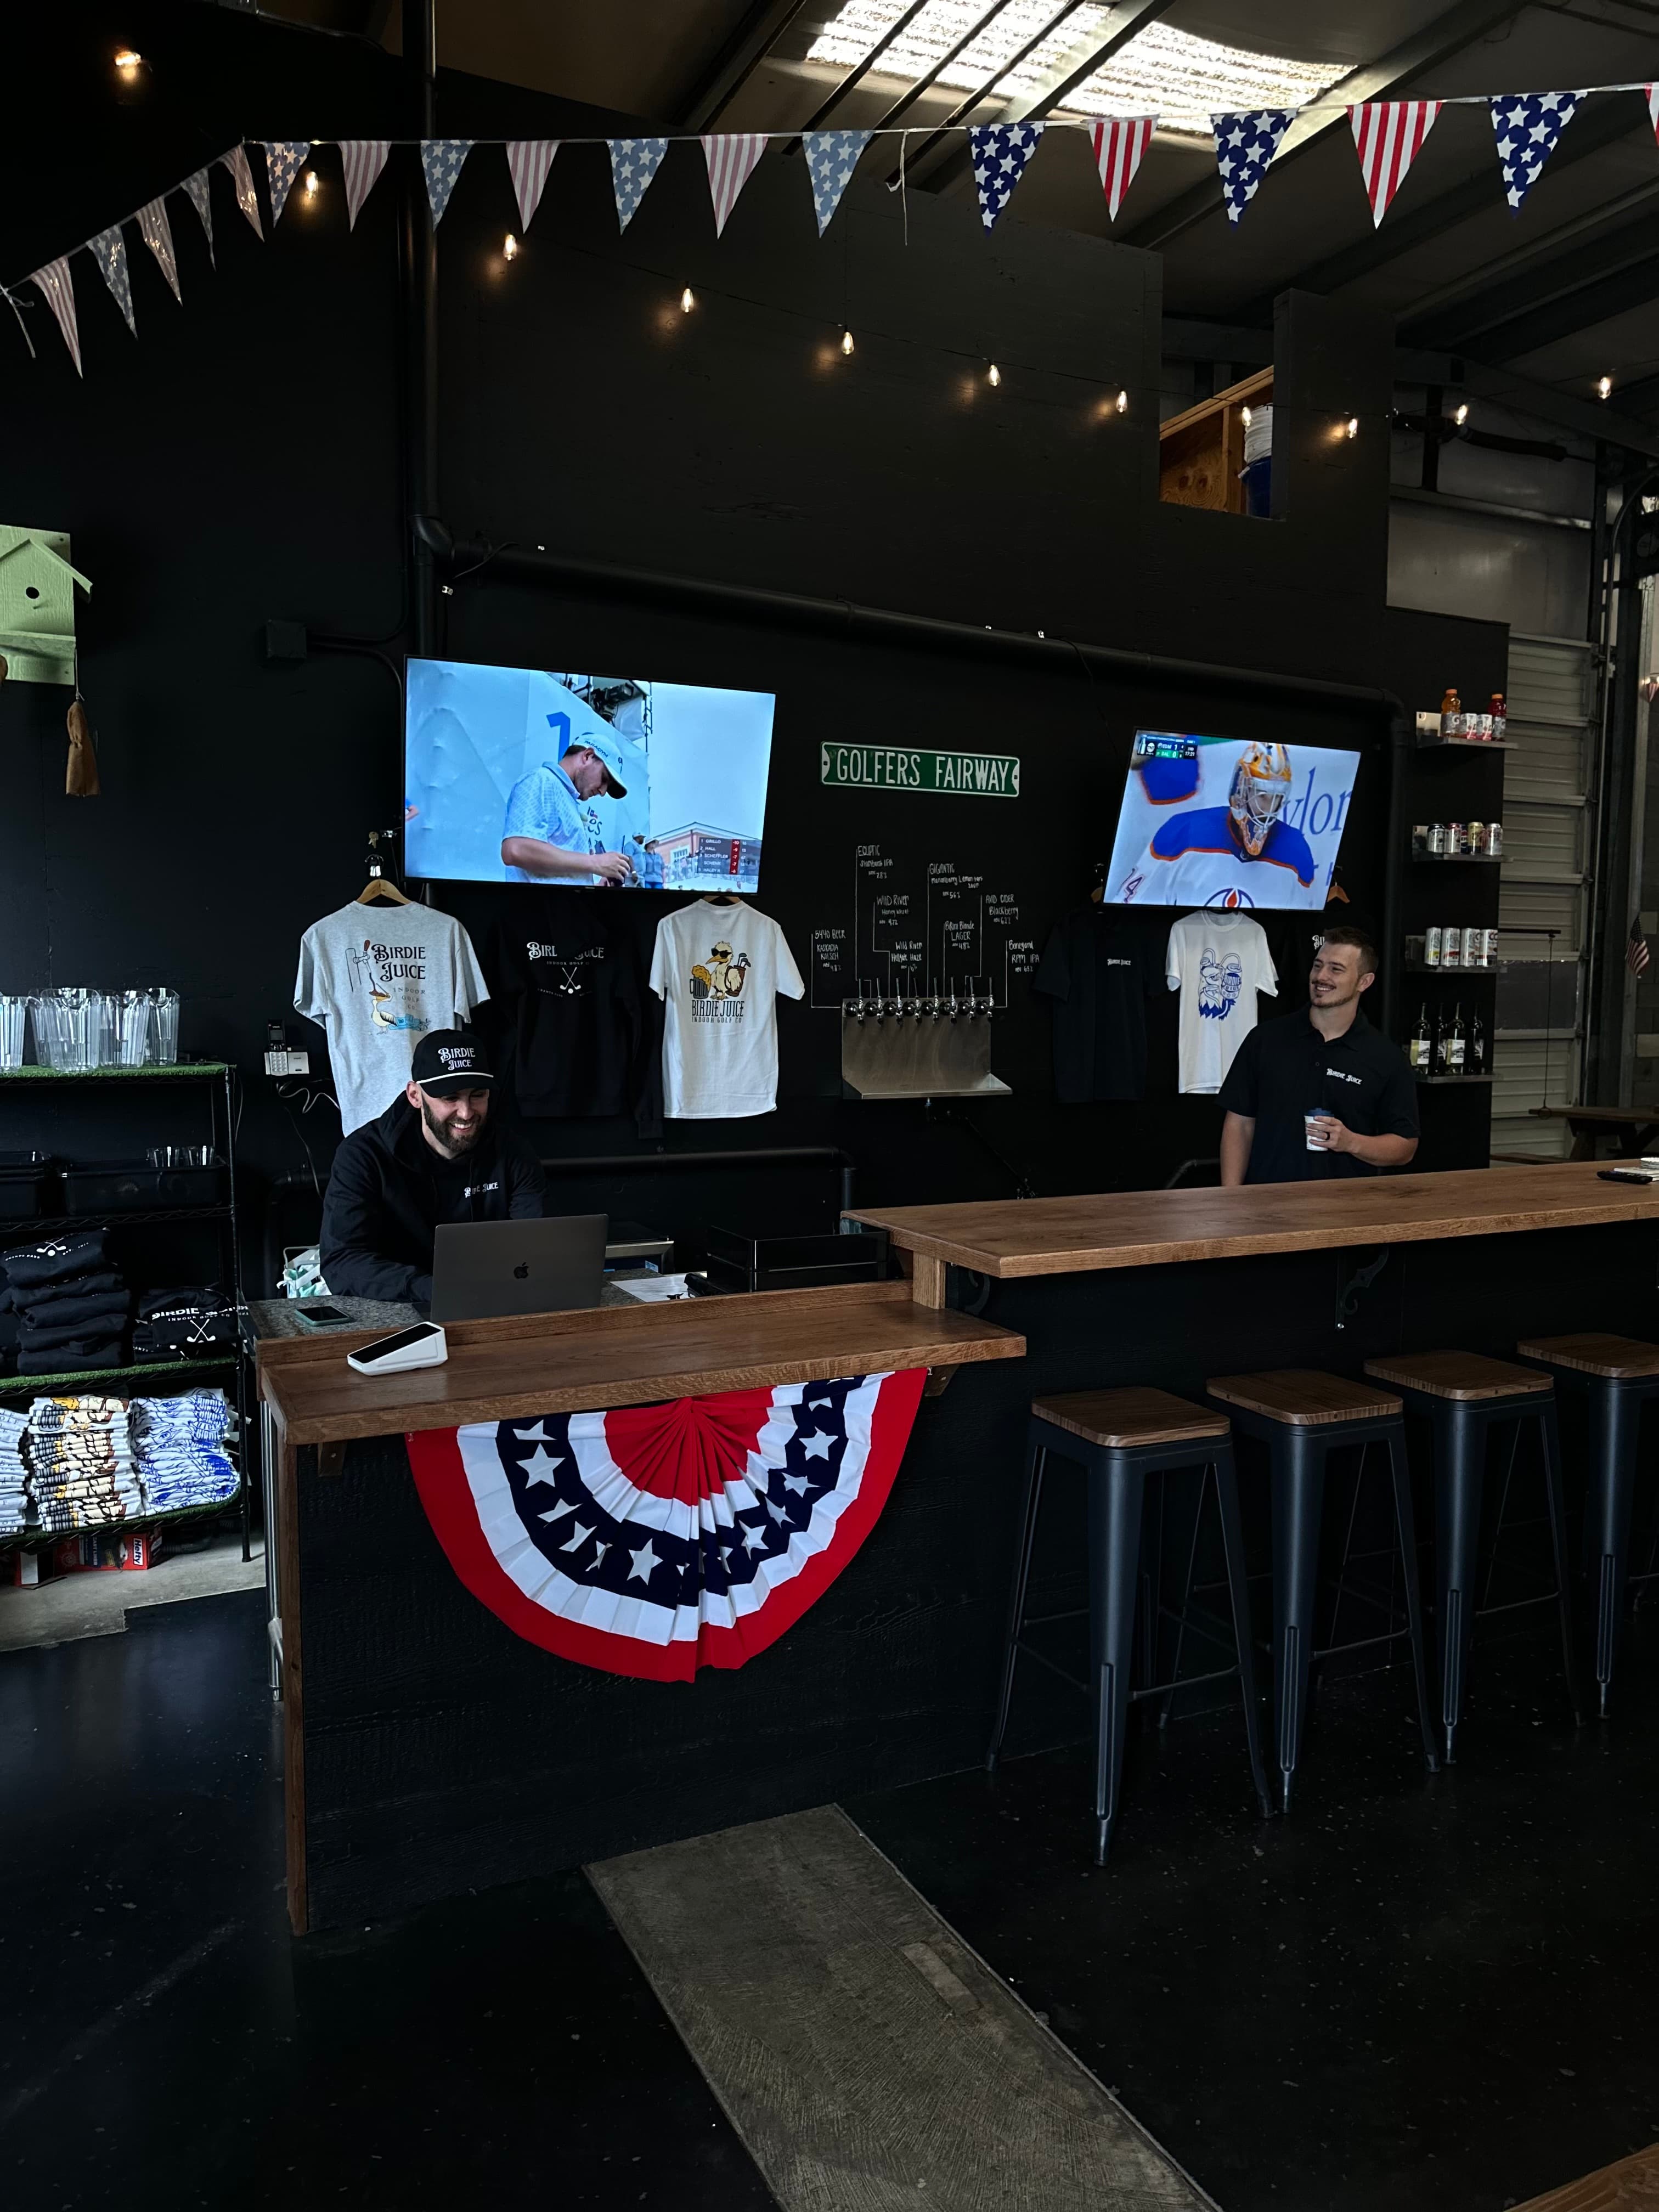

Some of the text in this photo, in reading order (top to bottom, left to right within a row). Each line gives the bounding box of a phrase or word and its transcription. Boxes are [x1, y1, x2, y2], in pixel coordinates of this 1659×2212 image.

[584, 740, 608, 758] PARADYM
[837, 748, 1009, 791] GOLFERS FAIRWAY
[815, 929, 831, 939] 5440
[951, 931, 971, 941] LAGER
[371, 944, 426, 964] BIRDIE
[1012, 953, 1040, 964] RPM IPA
[380, 962, 426, 982] JUICE
[393, 987, 426, 995] INDOOR
[692, 1000, 745, 1017] BIRDIE JUICE
[438, 1047, 476, 1063] BIRDIE
[448, 1059, 472, 1071] JUICE
[1327, 1068, 1362, 1085] BIRDIE JUICE
[482, 1182, 499, 1193] JUICE
[133, 1539, 142, 1563] Hefty
